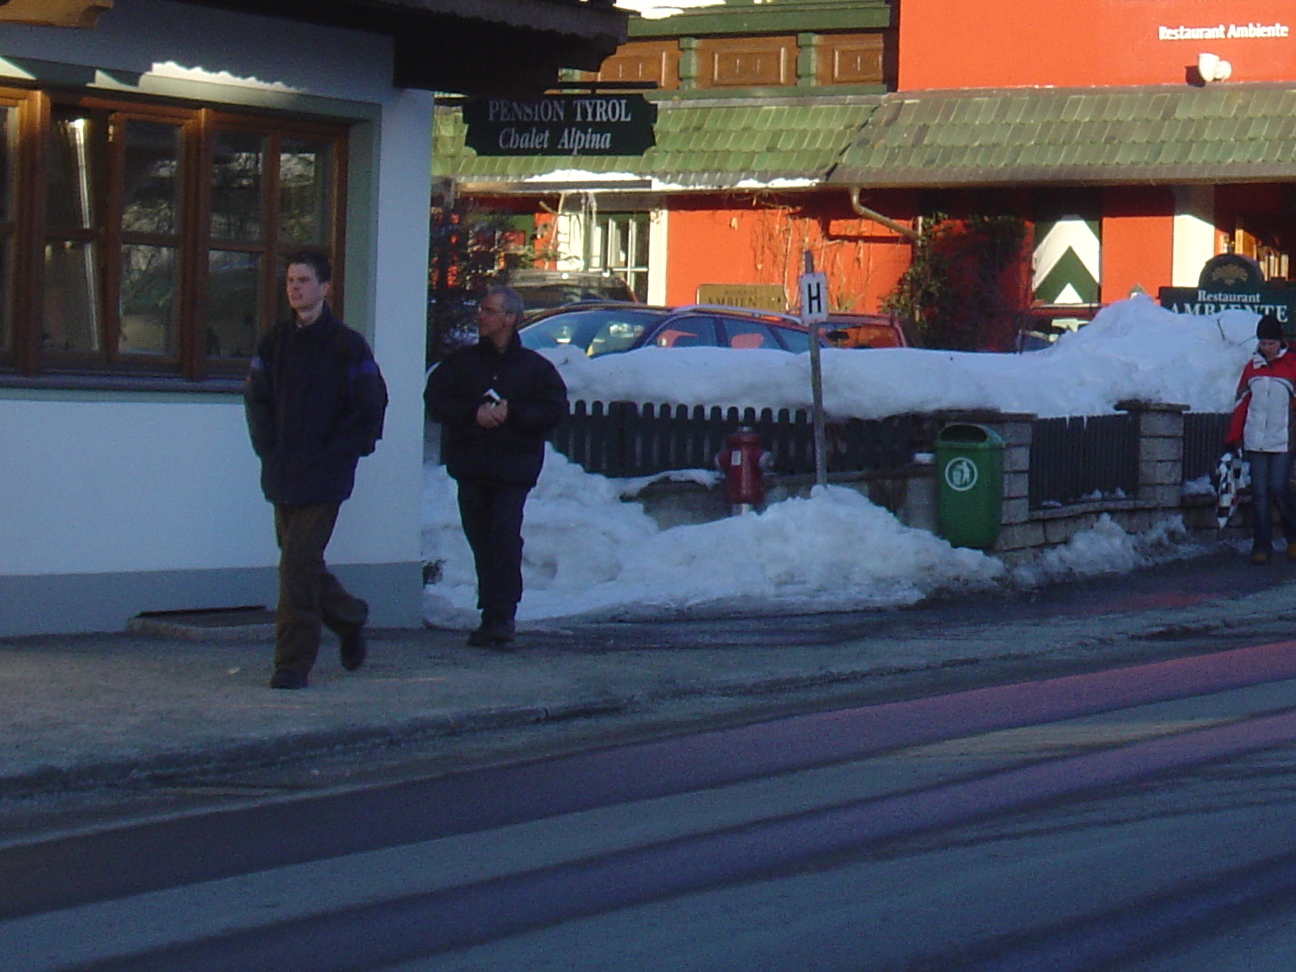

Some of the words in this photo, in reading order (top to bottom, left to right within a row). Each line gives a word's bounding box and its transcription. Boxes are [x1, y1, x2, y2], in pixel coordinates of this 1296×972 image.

[1158, 24, 1225, 40] Restaurant
[1227, 23, 1289, 38] Ambiente
[488, 99, 565, 121] PENSION
[573, 99, 632, 122] TYROL
[498, 127, 550, 149] Chalet
[557, 127, 612, 155] Alpina
[808, 282, 821, 314] H
[1197, 289, 1261, 302] Restaurant
